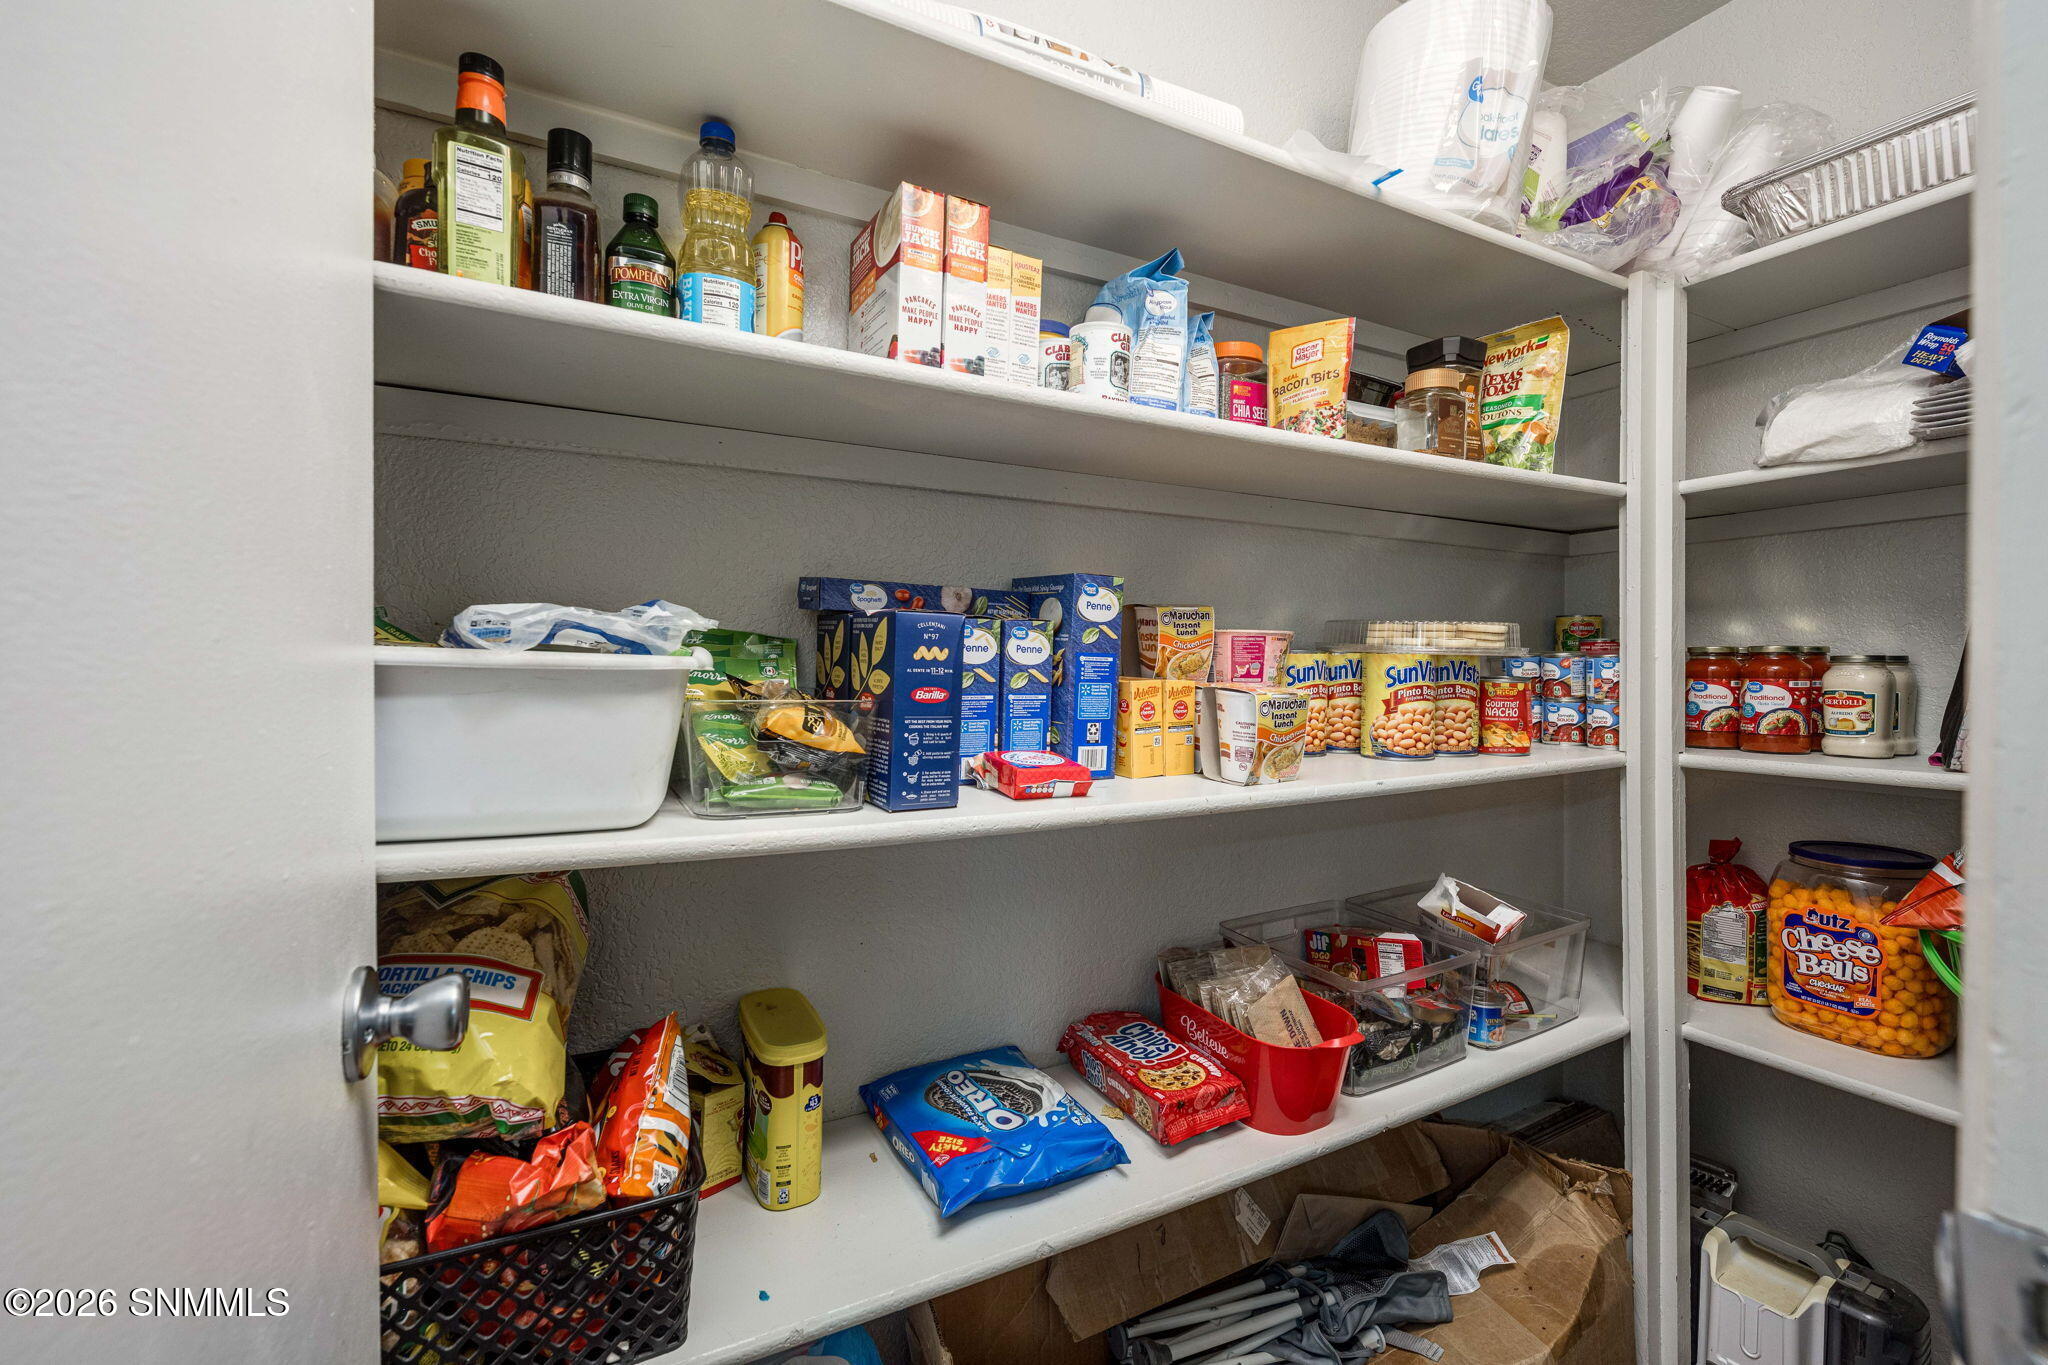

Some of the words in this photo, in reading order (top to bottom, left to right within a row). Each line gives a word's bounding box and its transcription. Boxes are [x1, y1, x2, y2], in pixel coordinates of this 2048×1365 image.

[1480, 126, 1519, 142] lates
[457, 146, 484, 160] Nutrition
[486, 152, 503, 164] Facts
[457, 166, 481, 178] Calories
[487, 174, 503, 183] 120
[903, 232, 941, 250] JACK
[950, 243, 987, 261] JACK
[614, 268, 667, 288] POMPEIAN
[704, 278, 726, 286] Nutrition
[1020, 274, 1035, 282] HONEY
[612, 290, 639, 301] EXTRA
[641, 292, 669, 308] VIRGIN
[704, 298, 723, 306] Calories
[728, 301, 739, 309] 120
[905, 296, 937, 310] PANCAKES
[626, 302, 644, 310] OLIVE
[952, 304, 981, 318] PANCAKES
[1015, 300, 1037, 311] MAKERS
[902, 305, 917, 315] MAKE
[918, 308, 938, 320] PEOPLE
[1015, 308, 1037, 318] WANTED
[908, 316, 933, 327] HAPPY
[948, 314, 964, 324] MAKE
[964, 317, 984, 328] PEOPLE
[954, 324, 978, 335] HAPPY
[1918, 338, 1939, 350] Wrap
[1924, 332, 1960, 345] Reynolds
[1296, 343, 1320, 355] Oscar
[1940, 342, 1956, 352] 50
[1295, 350, 1320, 362] Mayer
[1912, 350, 1948, 362] HEAVY
[1910, 358, 1937, 367] DUTY
[1273, 377, 1309, 399] Bacon
[1311, 369, 1340, 384] Bits
[1283, 373, 1299, 383] REAL
[1483, 368, 1523, 388] TEXAS
[1482, 378, 1523, 399] TOAST
[1232, 404, 1251, 419] CHIA
[1482, 401, 1513, 412] SEASONED
[856, 596, 883, 604] Spaghetti
[1086, 600, 1113, 612] Penne
[1170, 611, 1210, 620] Maruchan
[917, 622, 946, 630] CELLENTANI
[1016, 644, 1043, 654] Penne
[1173, 640, 1200, 649] Chicken
[930, 667, 945, 675] 11-12
[916, 690, 946, 700] Barilla
[1134, 686, 1161, 700] Velveeta
[1168, 686, 1194, 700] Velveeta
[1328, 685, 1351, 695] Pinto
[1398, 688, 1422, 699] Pinto
[1456, 685, 1477, 698] Beans
[1268, 699, 1307, 710] Maruchan
[1486, 699, 1520, 708] Gourmet
[1824, 698, 1863, 706] BERTOLLI
[1272, 712, 1298, 720] Instant
[1486, 708, 1519, 717] NACHO
[1274, 720, 1294, 728] Lunch
[1270, 732, 1293, 742] Chicken
[1456, 915, 1475, 928] Debbie
[1310, 934, 1330, 951] Jif
[1782, 927, 1882, 966] Cheese
[1319, 952, 1330, 960] GO
[1796, 952, 1870, 983] Balls
[463, 968, 517, 990] CHIPS
[1280, 1008, 1297, 1040] DOWN
[1120, 1022, 1177, 1053] Chips
[1180, 1015, 1229, 1059] Believe
[1190, 1054, 1223, 1078] CHEWY
[1107, 1077, 1131, 1100] CHEWY
[946, 1070, 1025, 1131] OREO
[938, 1136, 964, 1145] SIZE
[892, 1136, 915, 1163] OREO
[928, 1142, 968, 1153] PARTY
